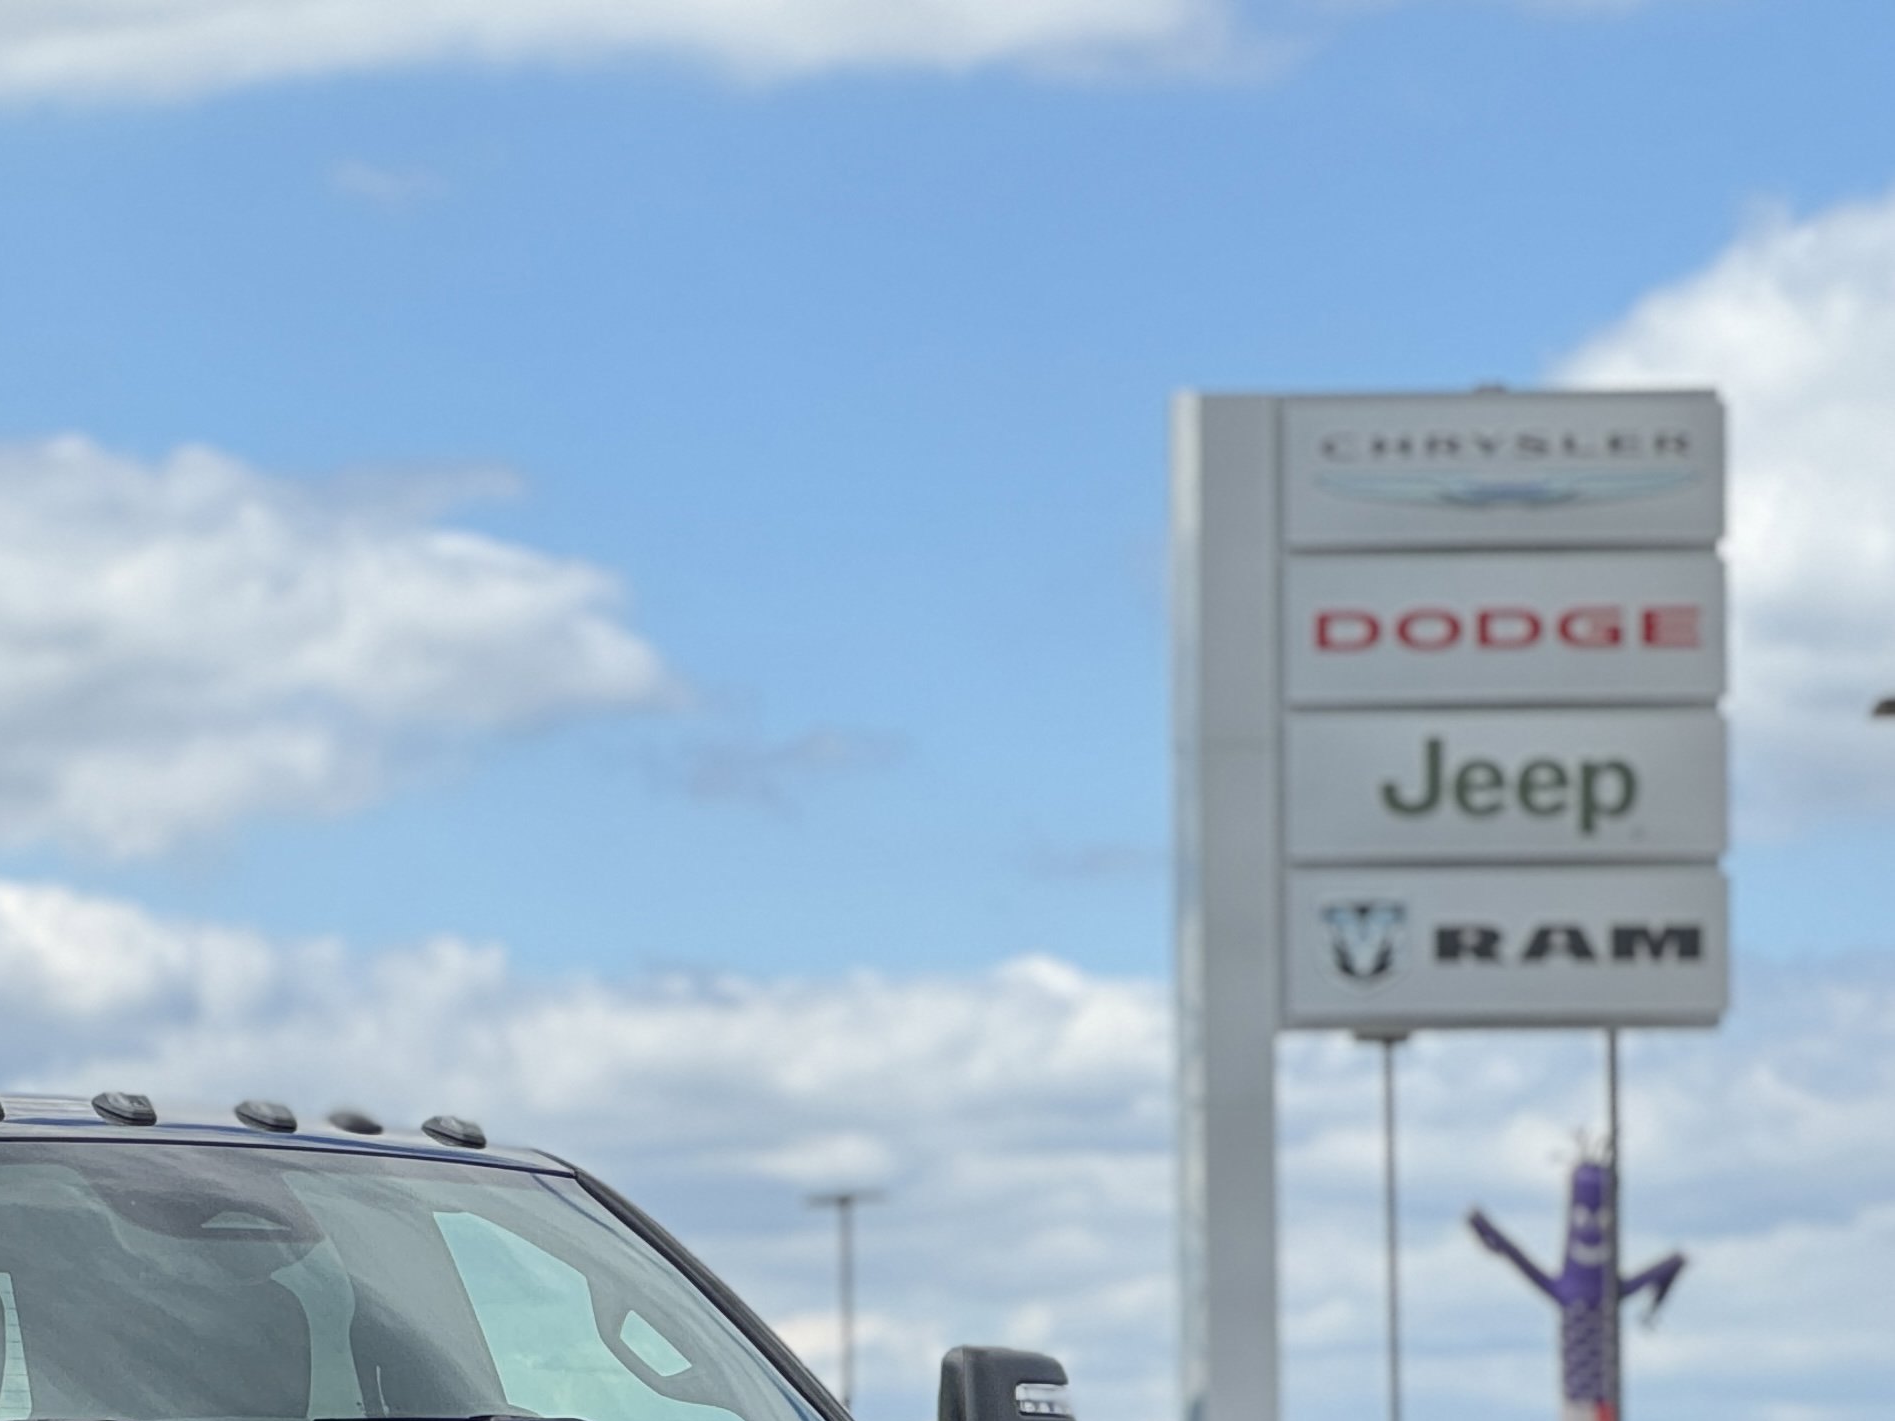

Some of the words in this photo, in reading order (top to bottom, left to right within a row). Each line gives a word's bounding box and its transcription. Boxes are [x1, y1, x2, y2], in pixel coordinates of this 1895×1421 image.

[1320, 431, 1691, 462] CHRYSLER
[1316, 607, 1702, 652] DODGE
[1381, 738, 1638, 834] Jeep
[1434, 925, 1702, 962] RAM
